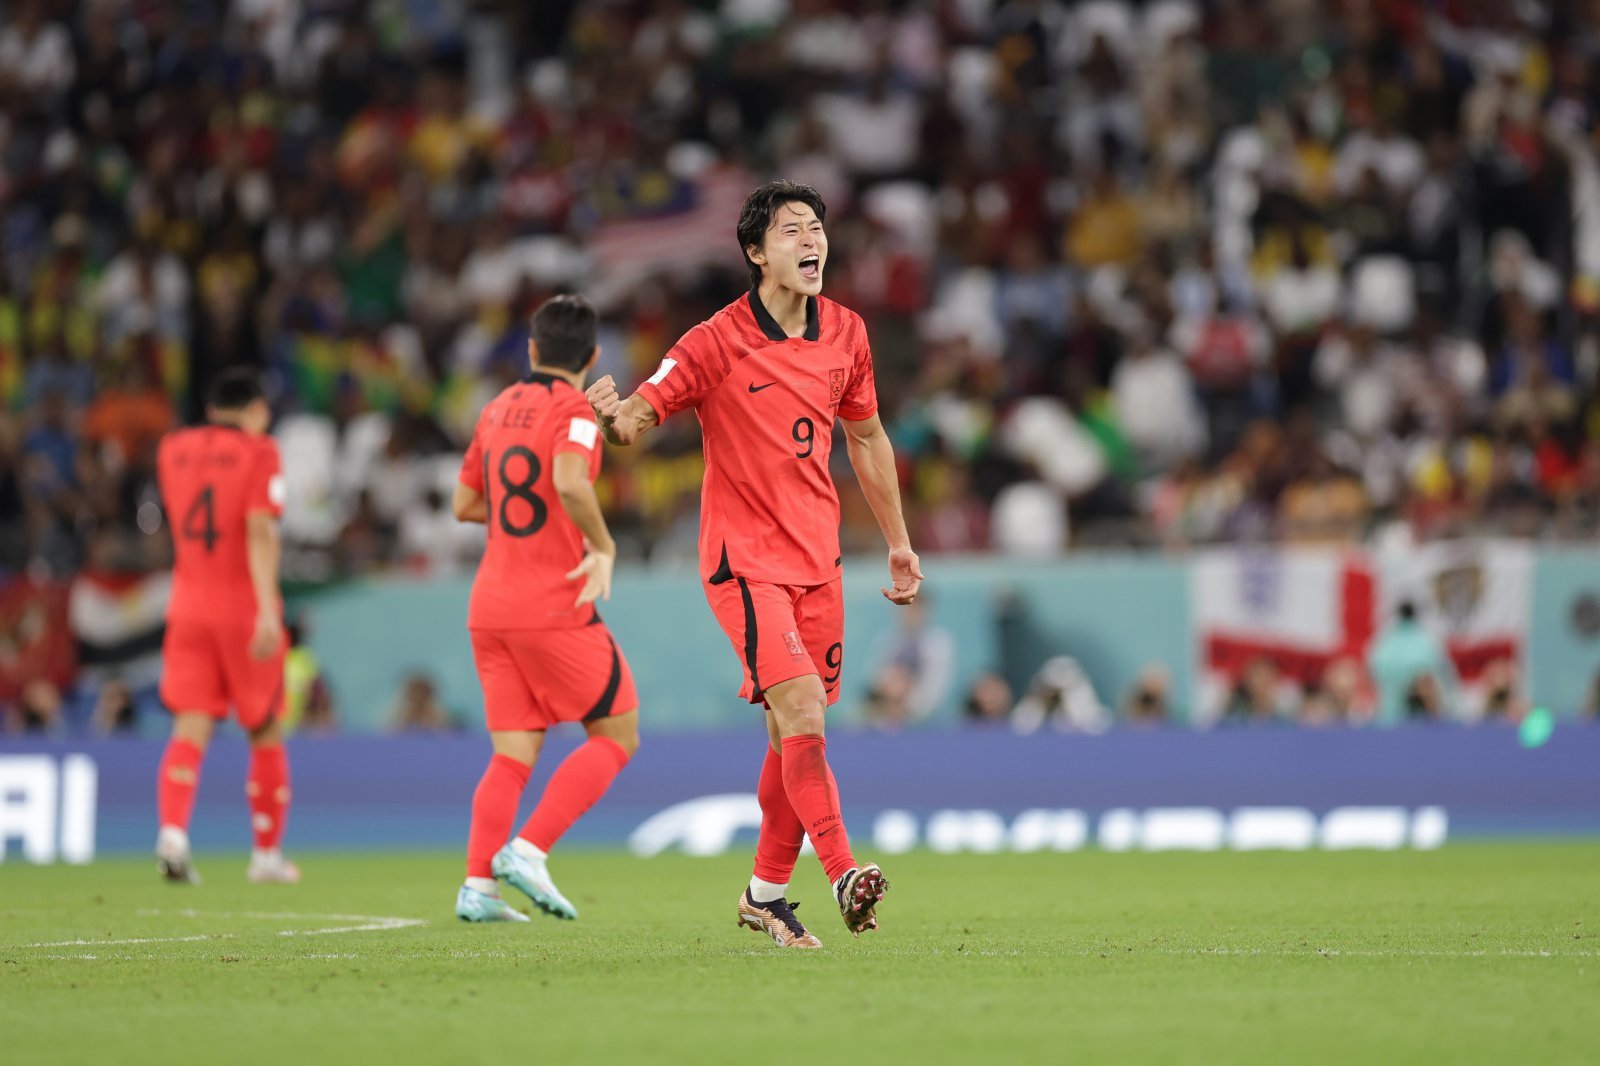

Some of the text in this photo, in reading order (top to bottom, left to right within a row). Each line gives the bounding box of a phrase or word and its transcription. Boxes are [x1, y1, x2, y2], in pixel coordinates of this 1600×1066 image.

[502, 408, 536, 429] LEE
[792, 416, 814, 459] 9
[484, 445, 548, 539] 18
[182, 484, 222, 553] 4
[824, 641, 842, 683] 9
[812, 814, 841, 828] KOREA
